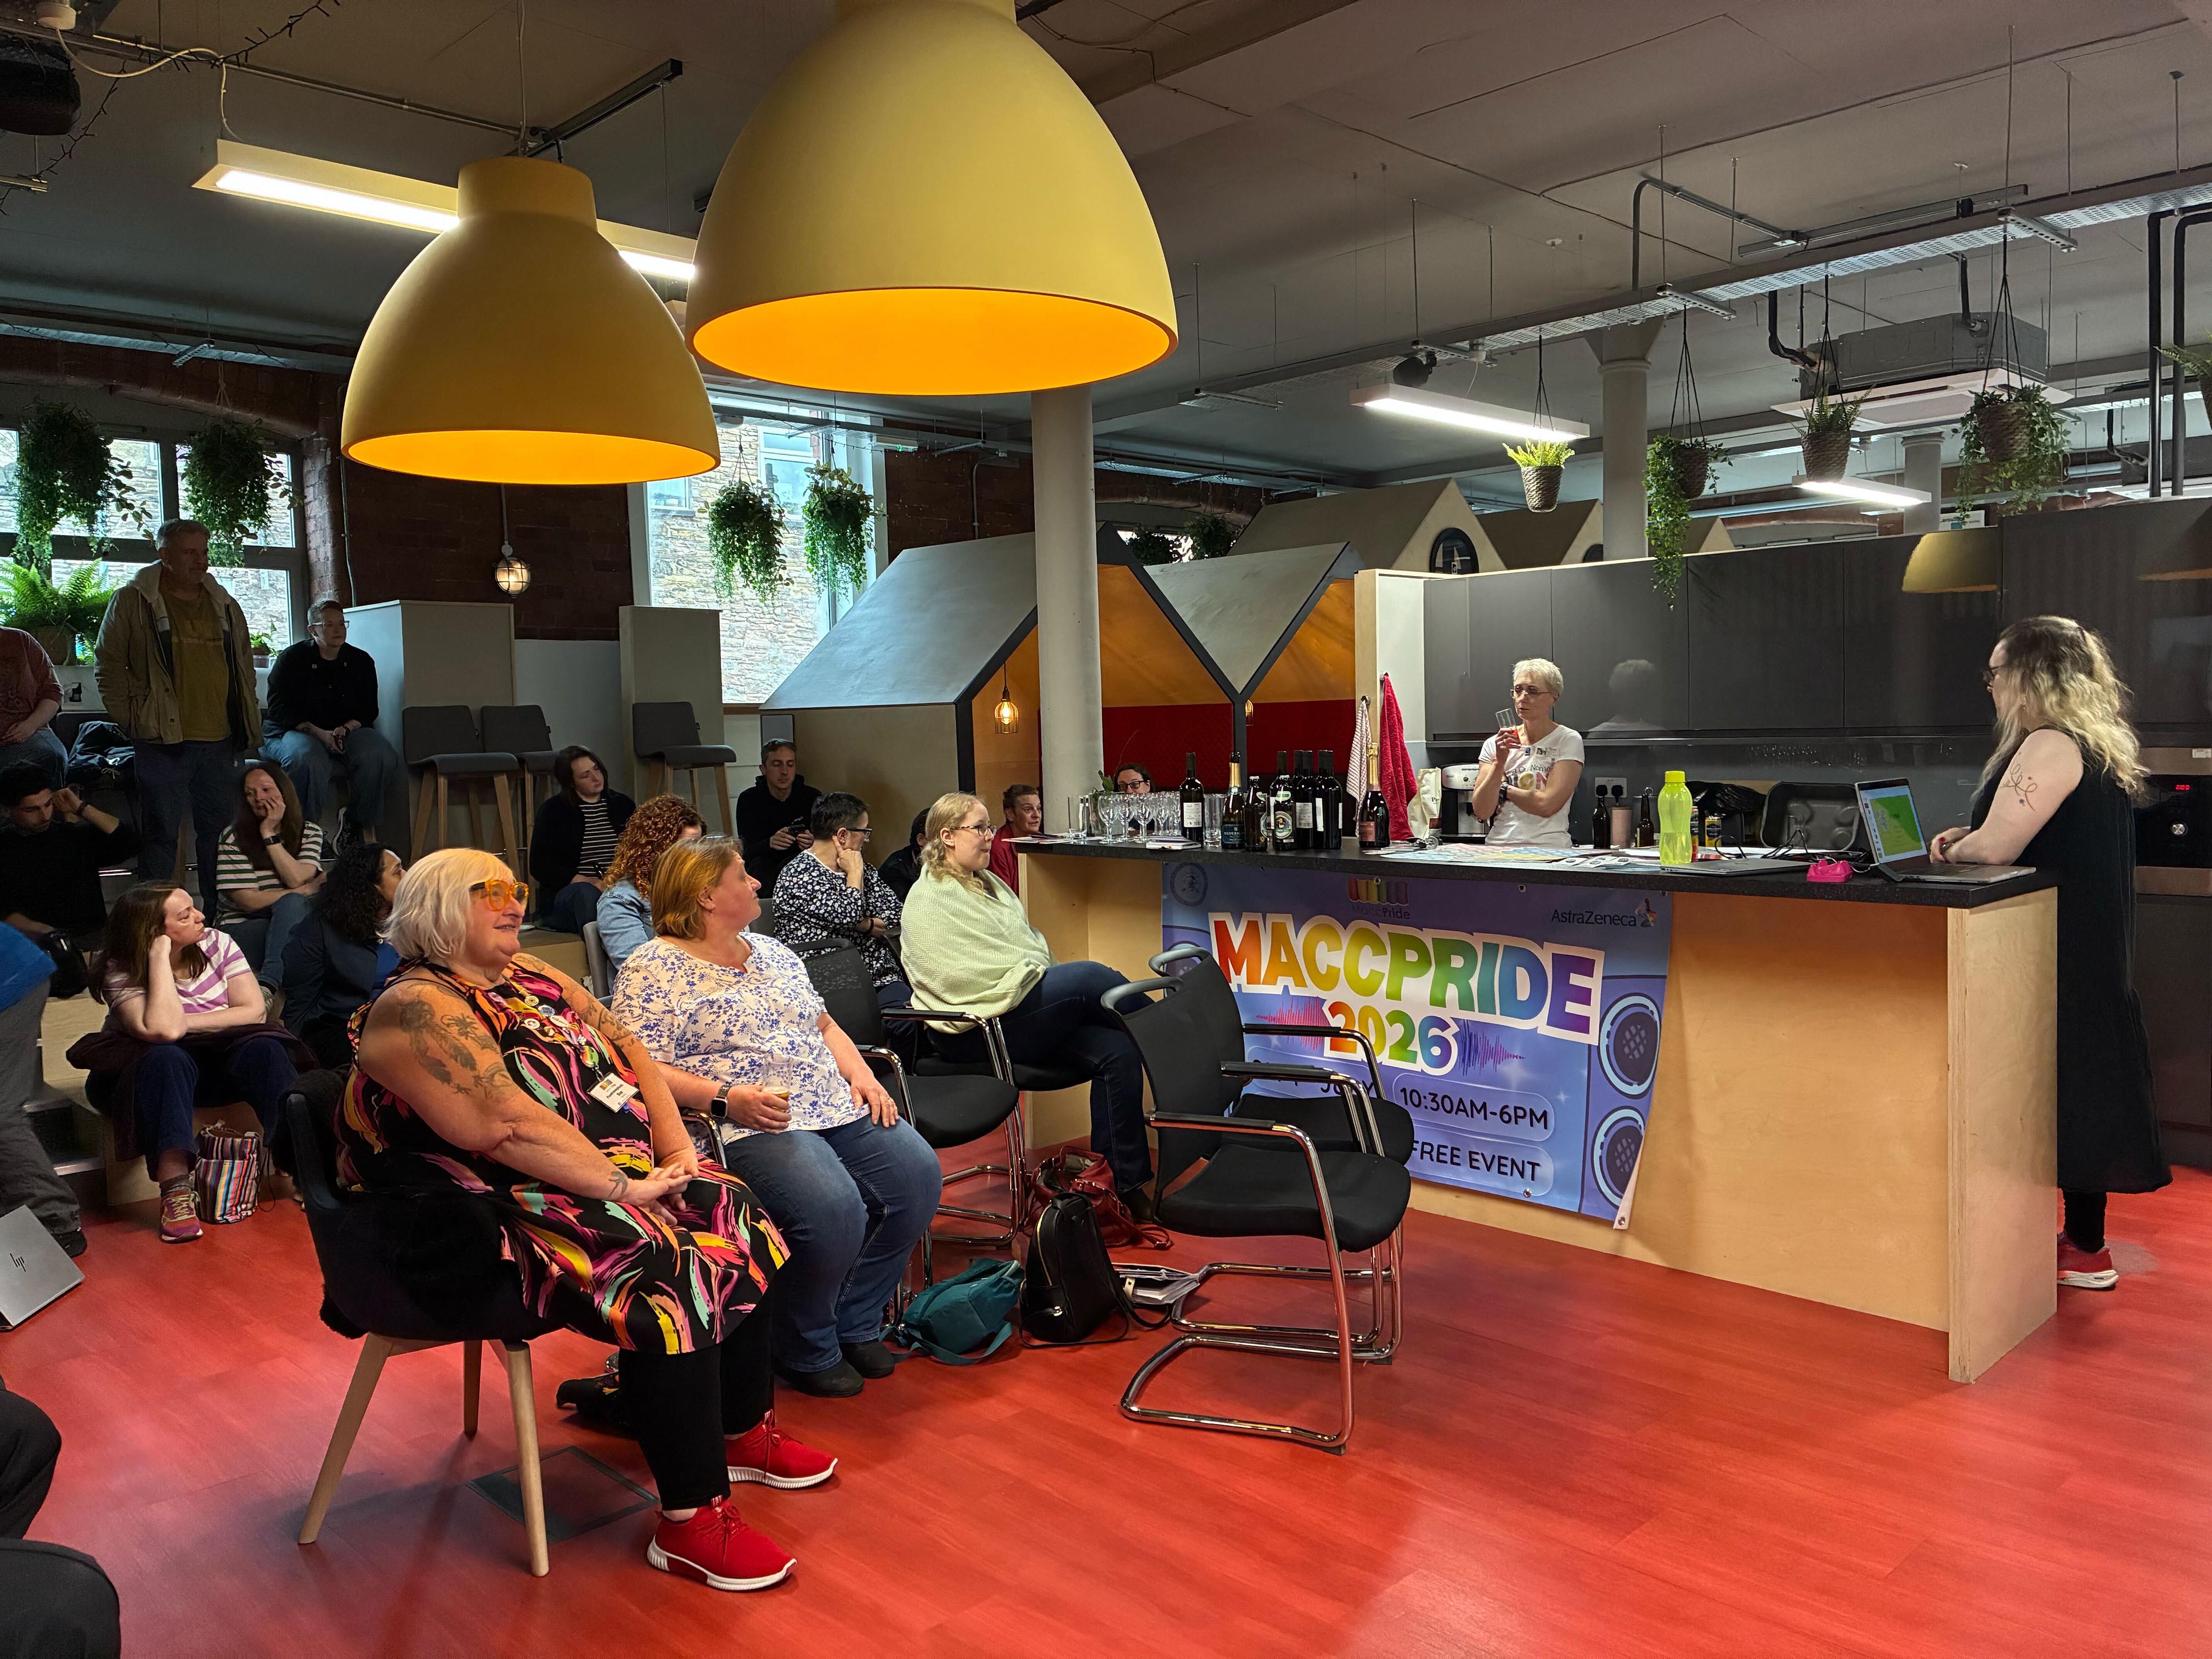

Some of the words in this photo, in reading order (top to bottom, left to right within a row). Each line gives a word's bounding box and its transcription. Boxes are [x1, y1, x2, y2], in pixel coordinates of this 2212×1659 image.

[1351, 904, 1410, 919] MaccPride
[1551, 909, 1637, 927] AstraZeneca
[1213, 919, 1596, 1035] MACCPRIDE
[1327, 1001, 1453, 1068] 2026
[1400, 1087, 1548, 1130] 10:30AM-6PM
[1468, 1150, 1541, 1181] EVENT
